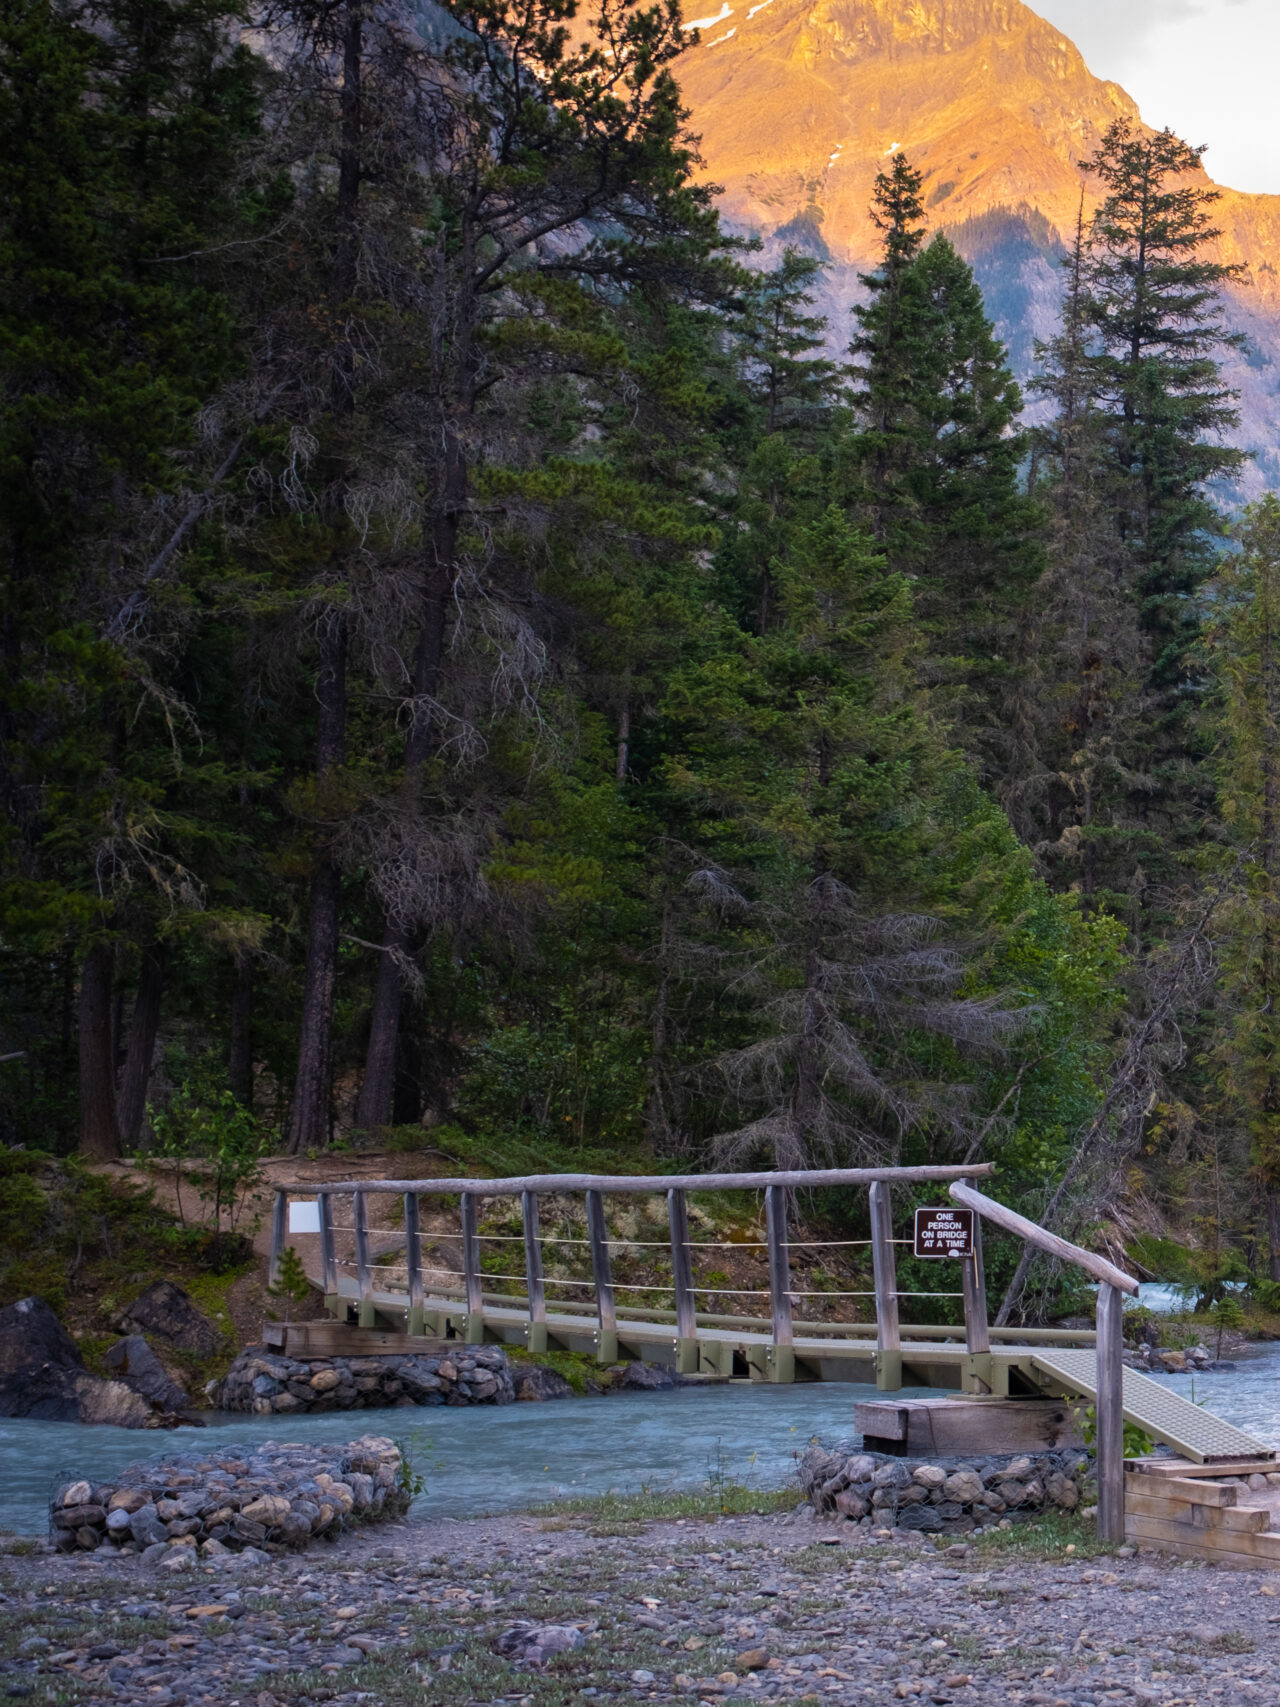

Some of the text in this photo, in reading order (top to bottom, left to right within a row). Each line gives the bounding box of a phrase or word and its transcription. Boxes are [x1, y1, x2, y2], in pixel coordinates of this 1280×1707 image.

[936, 1213, 954, 1221] ONE
[928, 1222, 962, 1230] PERSON
[921, 1231, 968, 1239] ON BRIDGE
[924, 1240, 965, 1248] AT A TIME
